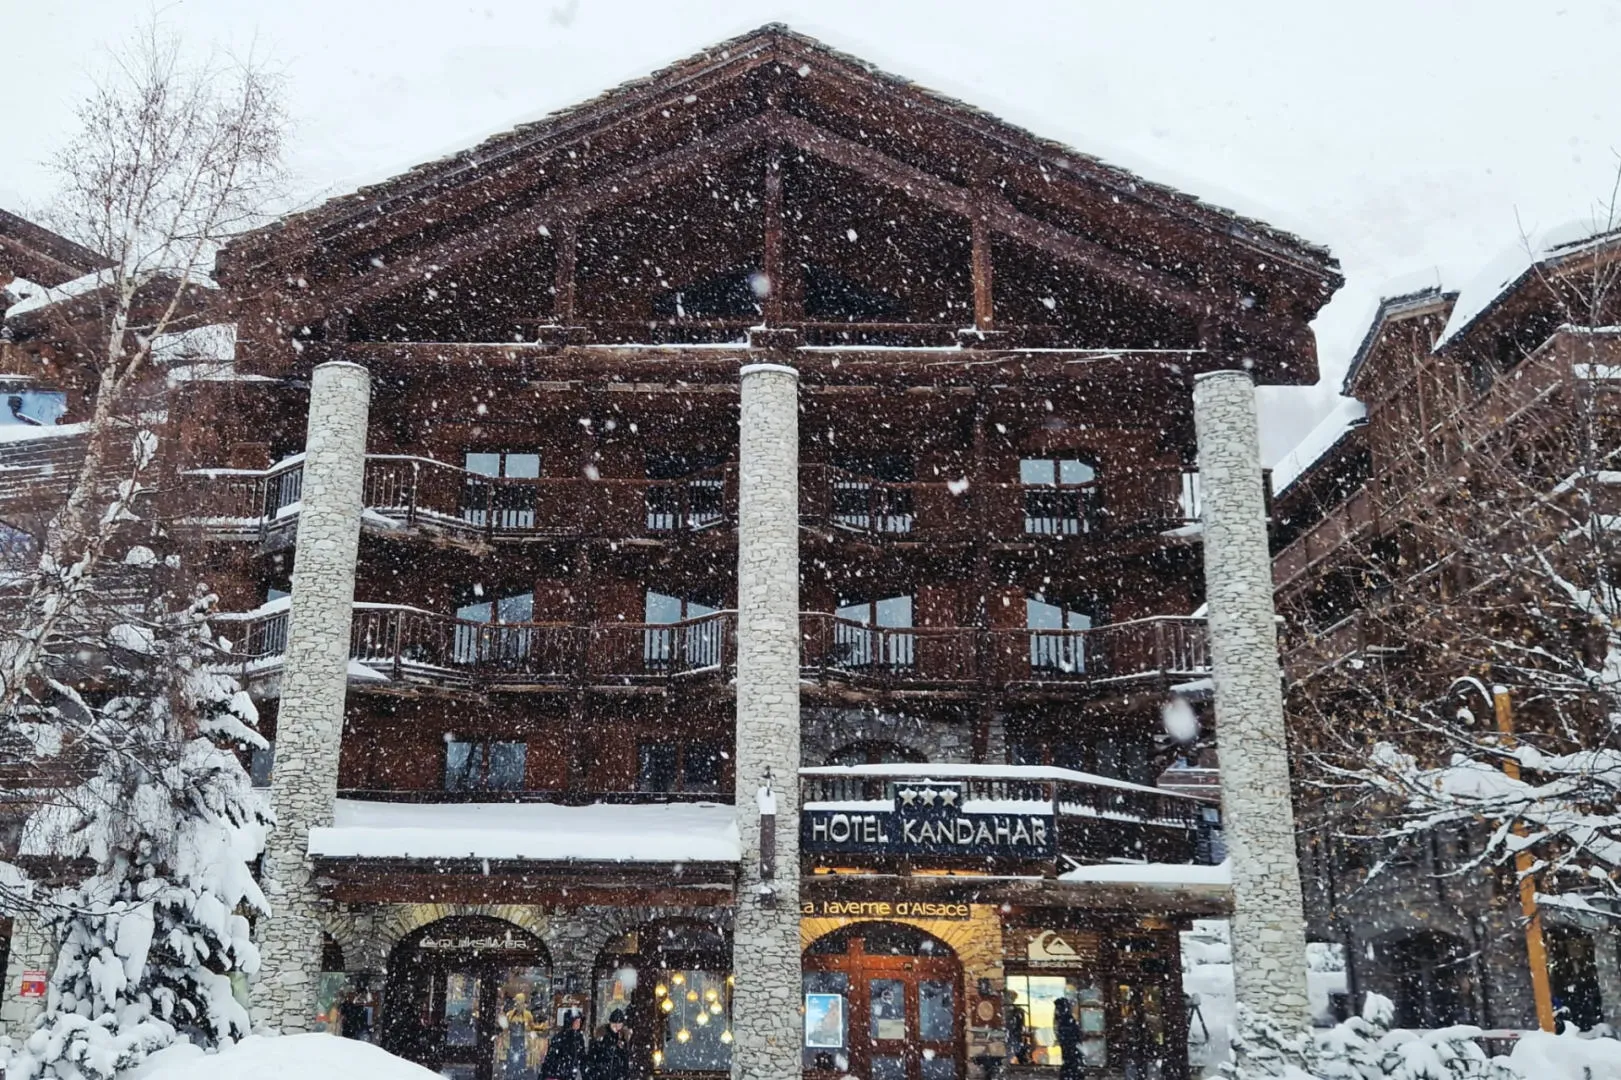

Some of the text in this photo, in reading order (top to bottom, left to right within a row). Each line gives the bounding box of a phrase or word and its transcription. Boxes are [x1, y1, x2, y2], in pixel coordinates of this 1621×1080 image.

[812, 814, 1047, 846] HOTEL KANDAHAR
[896, 901, 969, 917] d'Alsace
